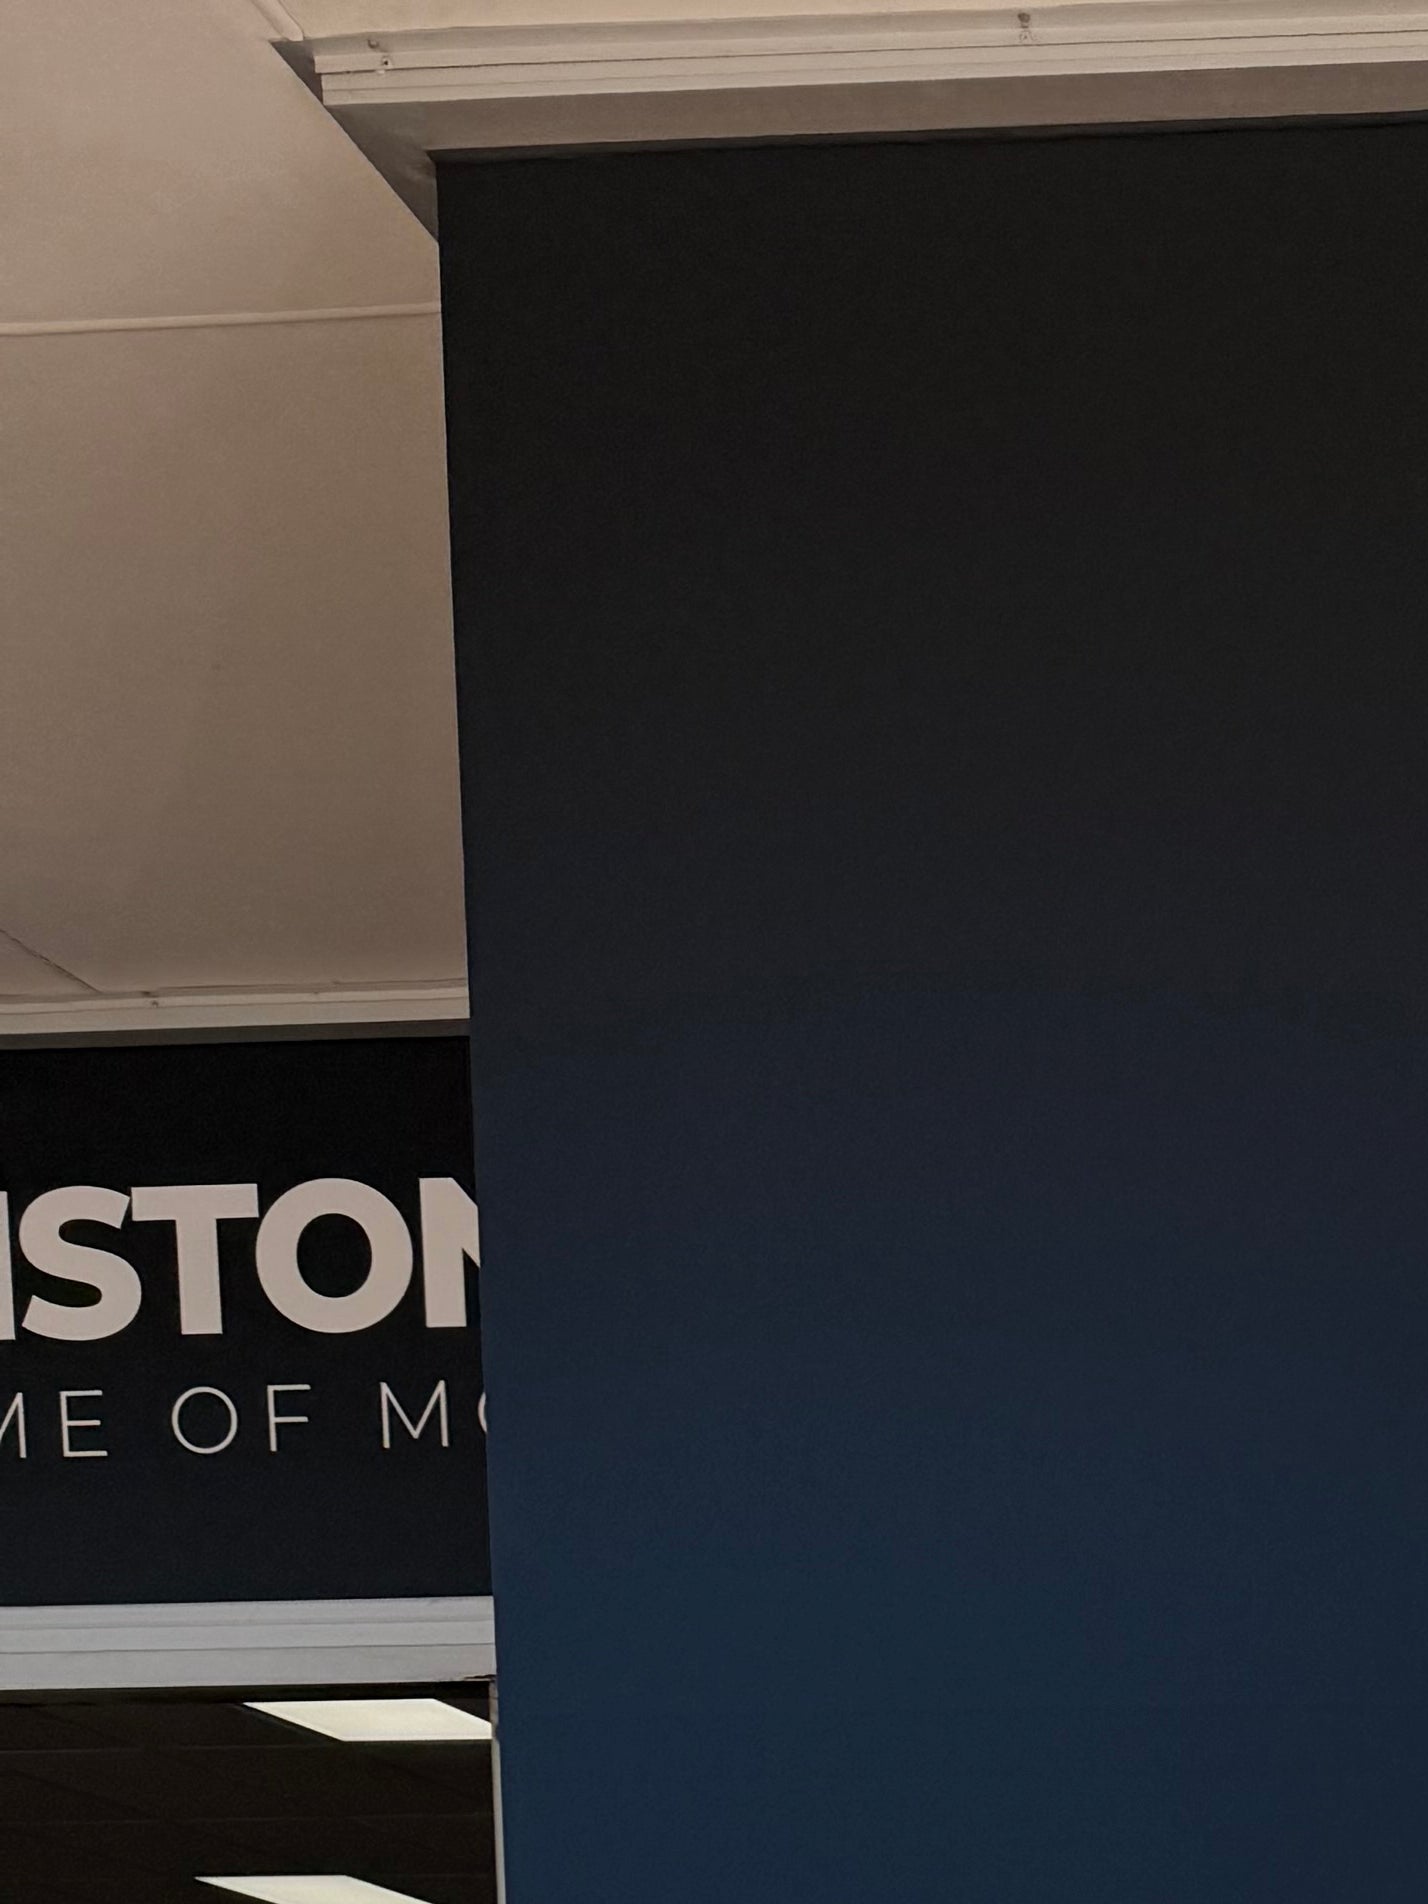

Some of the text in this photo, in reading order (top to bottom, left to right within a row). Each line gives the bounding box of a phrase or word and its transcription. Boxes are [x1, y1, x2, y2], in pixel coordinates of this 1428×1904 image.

[0, 1178, 481, 1341] STO
[172, 1384, 311, 1453] OF
[380, 1380, 486, 1448] M
